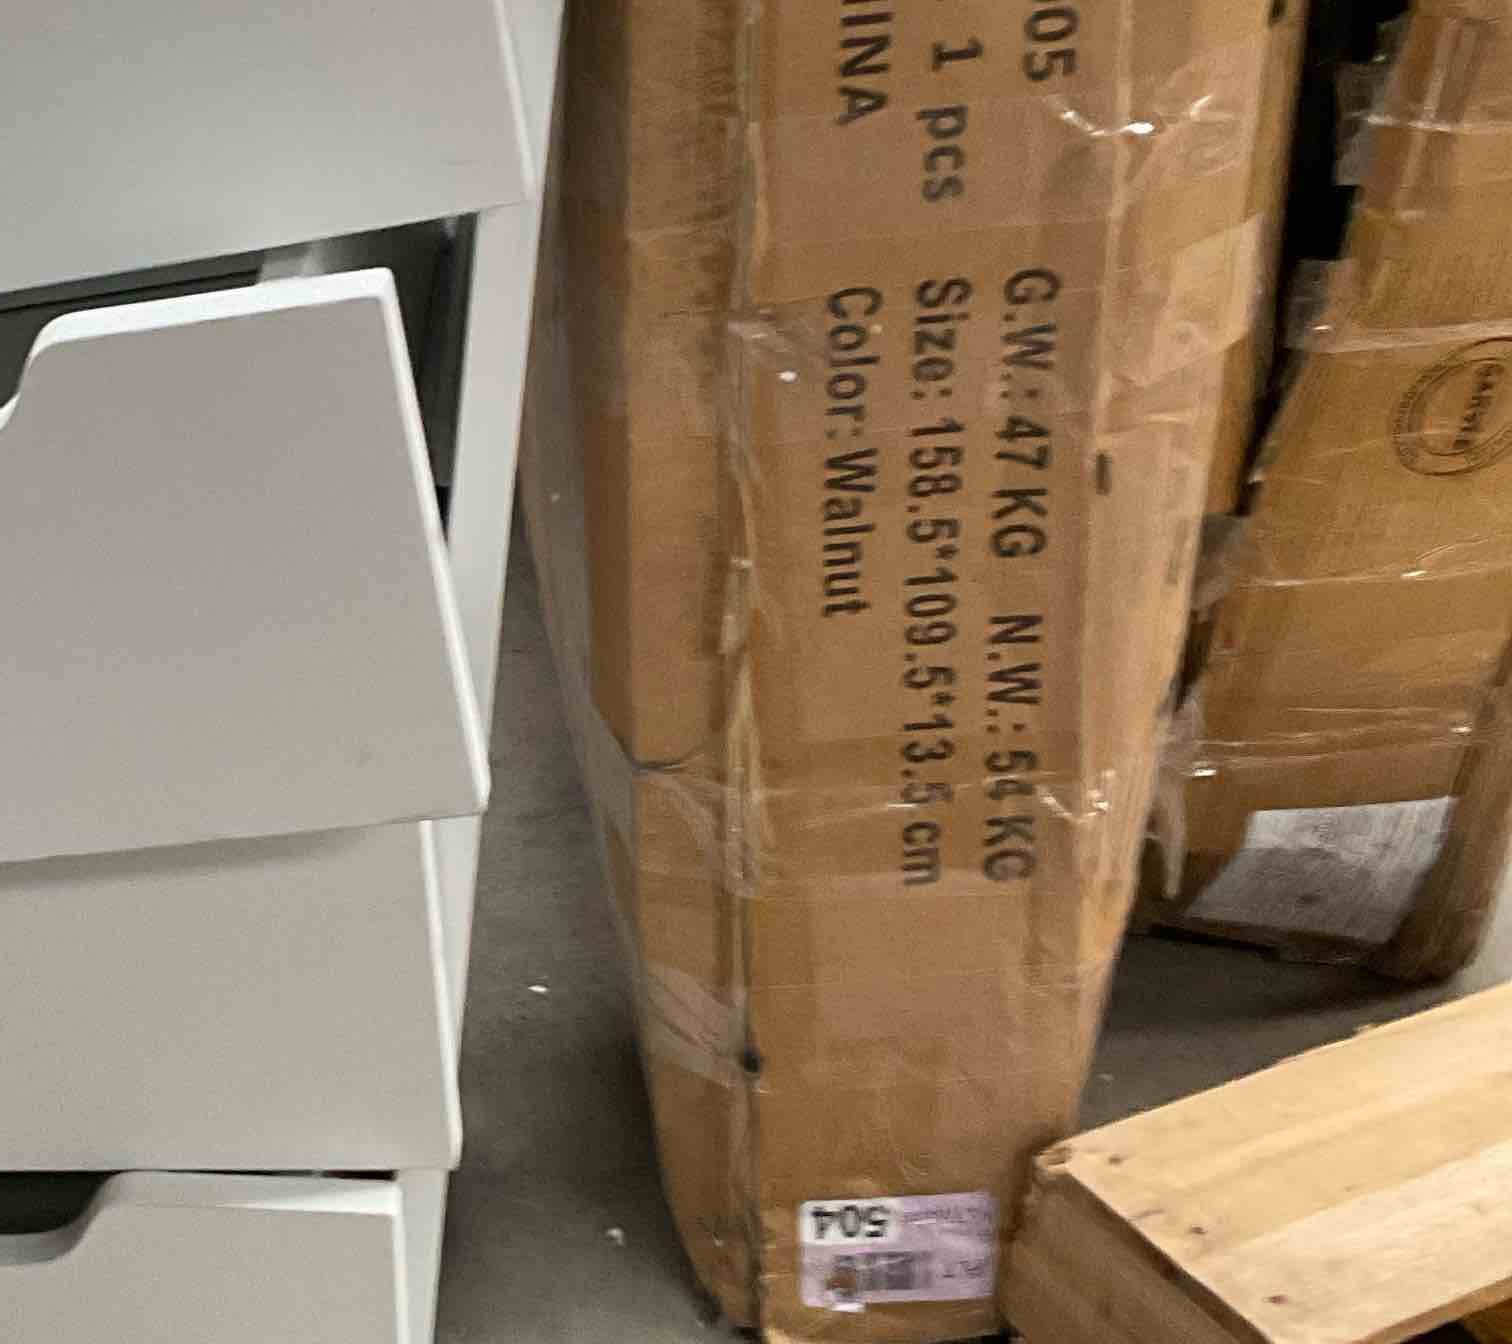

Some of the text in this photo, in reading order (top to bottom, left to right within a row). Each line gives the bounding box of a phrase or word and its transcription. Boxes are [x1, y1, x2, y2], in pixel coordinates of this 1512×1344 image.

[931, 40, 984, 71] 1
[918, 105, 967, 203] pcs
[910, 278, 973, 399] Size:
[982, 268, 1061, 881] G.W.: 47 KG N.W.: 54 KG
[902, 821, 943, 887] cm
[810, 1205, 888, 1238] 504
